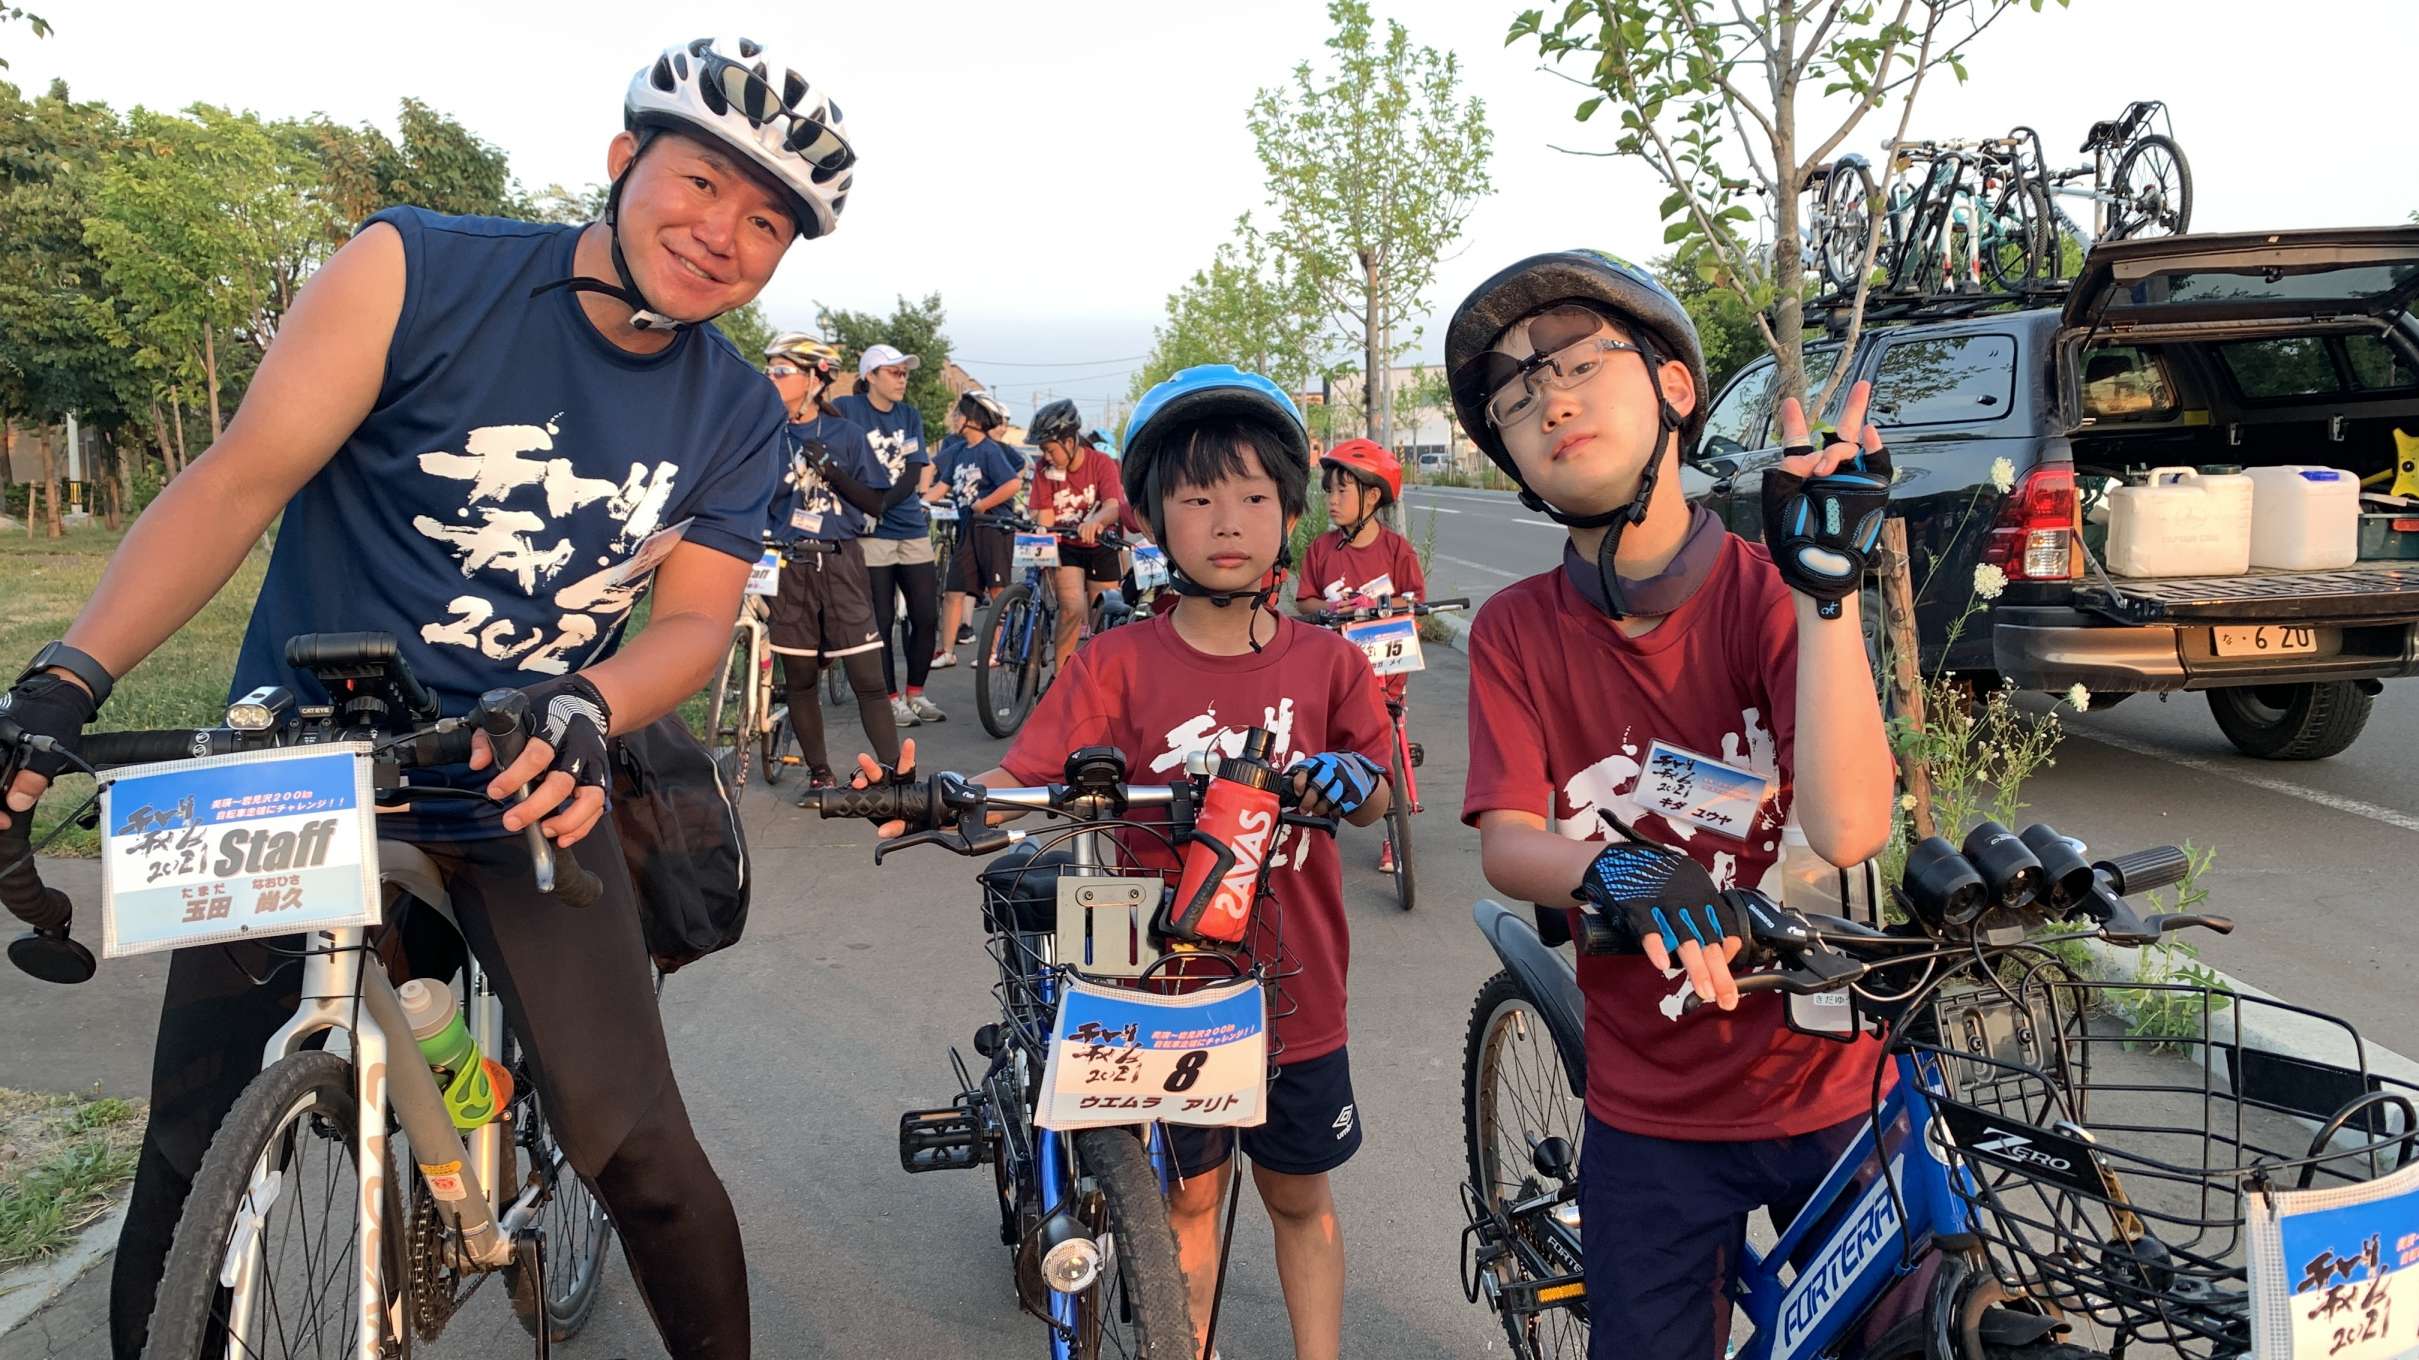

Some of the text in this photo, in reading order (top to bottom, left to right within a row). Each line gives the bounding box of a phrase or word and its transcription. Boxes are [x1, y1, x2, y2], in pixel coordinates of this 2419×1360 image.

[1385, 640, 1402, 658] 15
[1659, 797, 1733, 826] キダ ユウヤ
[213, 818, 338, 878] Staff
[1214, 809, 1272, 920] SAVAS
[181, 875, 301, 899] たまだ なおひさ
[182, 888, 304, 923] 玉田 尚久
[1162, 1050, 1208, 1093] 8
[1080, 1094, 1239, 1113] ウエムラ アリト
[1972, 1125, 2072, 1172] ZERO
[1784, 1190, 1897, 1349] FORTERA
